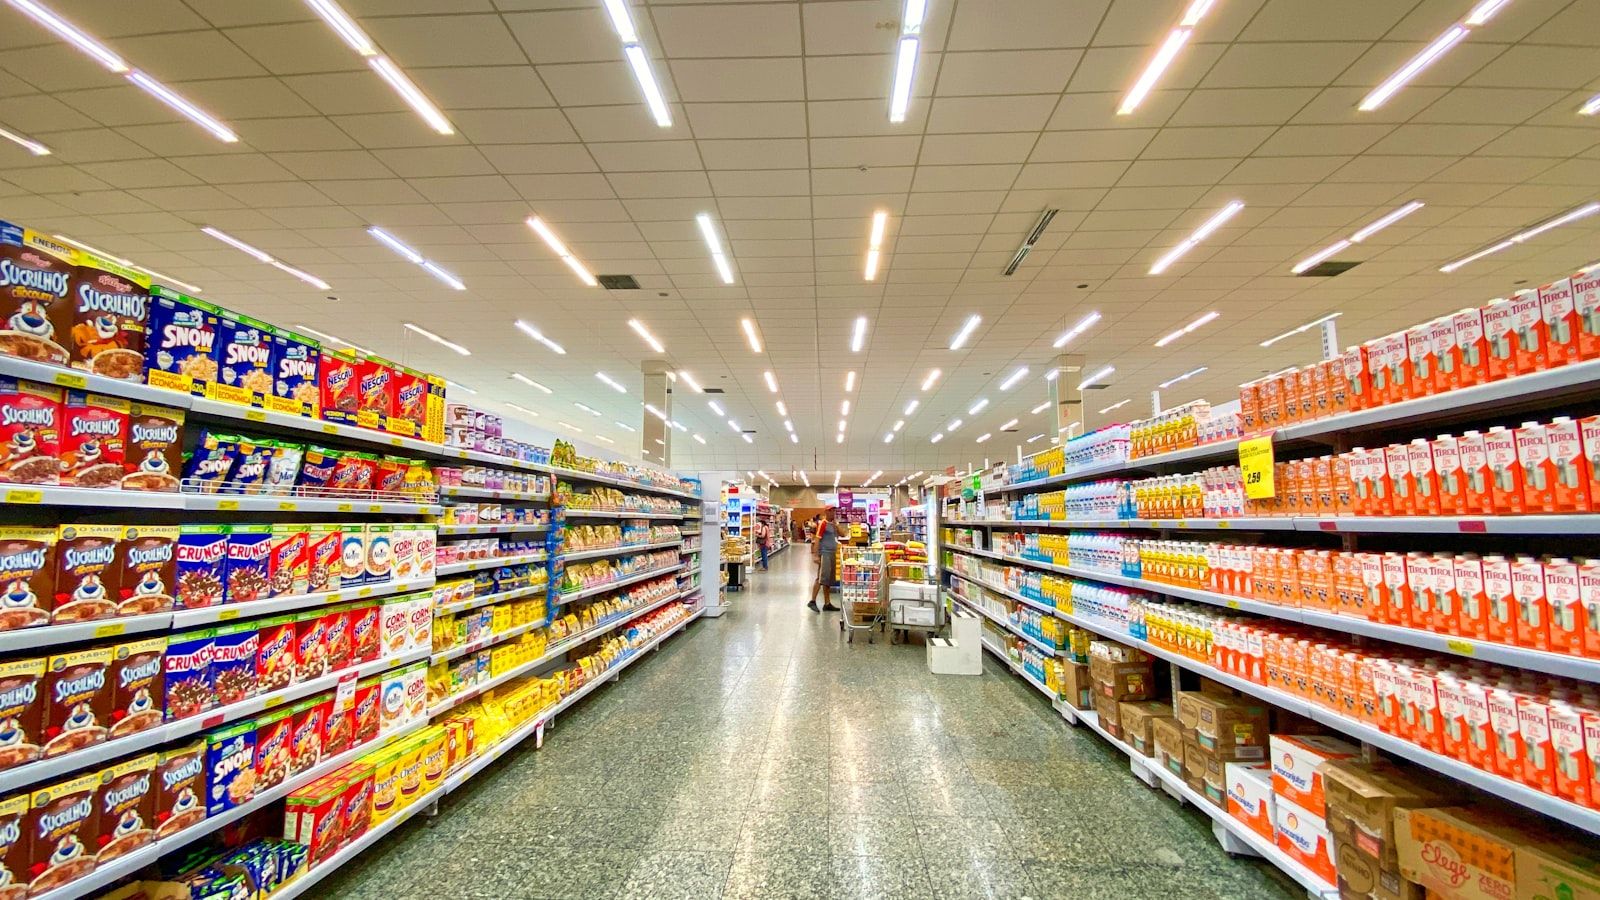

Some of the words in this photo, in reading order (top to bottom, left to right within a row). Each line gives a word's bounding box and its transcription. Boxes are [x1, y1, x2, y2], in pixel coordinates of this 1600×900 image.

[0, 259, 70, 298] SUCRILHOS
[1574, 278, 1600, 294] TIRO
[79, 284, 147, 322] SUCRILHOS
[1542, 290, 1571, 305] TIROL
[1511, 300, 1539, 315] TIROL
[1484, 309, 1510, 324] TIROL
[1431, 327, 1455, 339] TIROL
[1456, 319, 1481, 332] TIROL
[161, 324, 215, 349] SNOW
[1409, 334, 1430, 346] TIROL
[225, 343, 270, 365] SNOW
[278, 358, 317, 379] SNOW
[327, 367, 354, 388] NESCAU
[360, 371, 391, 394] NESCAU
[399, 383, 424, 403] NESCAU
[2, 404, 54, 427] SUCRILHOS
[71, 416, 121, 436] SUCRILHOS
[132, 423, 178, 444] SUCRILHOS
[1584, 428, 1600, 439] TIR
[1486, 441, 1513, 451] TIROL
[1518, 436, 1546, 447] TIROL
[1548, 432, 1577, 444] TIROL
[1435, 448, 1457, 458] TIROL
[1460, 444, 1483, 454] TIROL
[195, 458, 233, 475] SNOW
[177, 541, 226, 561] CRUNCH
[228, 540, 271, 559] CRUNCH
[279, 537, 305, 562] NESCAU
[394, 540, 413, 554] CORN
[417, 538, 433, 553] CORN
[65, 543, 116, 571] SUCRILHOS
[128, 543, 173, 568] SUCRILHOS
[1408, 565, 1429, 575] TIROL
[1429, 566, 1452, 577] TIROL
[1456, 568, 1480, 579] TIROL
[1485, 570, 1509, 581] TIROL
[1512, 572, 1542, 584] TIROL
[1547, 574, 1577, 586] TIROL
[386, 612, 405, 628] CORN
[411, 608, 429, 623] CORN
[260, 630, 293, 663] NESCAU
[300, 624, 326, 655] NESCAU
[214, 637, 259, 660] CRUNCH
[166, 645, 214, 671] CRUNCH
[121, 656, 161, 688] SUCRILHOS
[56, 668, 106, 702] SUCRILHOS
[1439, 689, 1460, 702] TIROL
[1462, 695, 1486, 710] TIROL
[1490, 702, 1516, 717] TIROL
[1519, 710, 1546, 726] TIROL
[293, 710, 320, 745] NESCAU
[1551, 718, 1580, 735] TIROL
[259, 724, 289, 764] NESCAU
[163, 756, 203, 791] SUCRILHOS
[213, 746, 254, 784] SNOW
[105, 774, 150, 813] SUCRILHOS
[40, 795, 92, 838] SUCRILHOS
